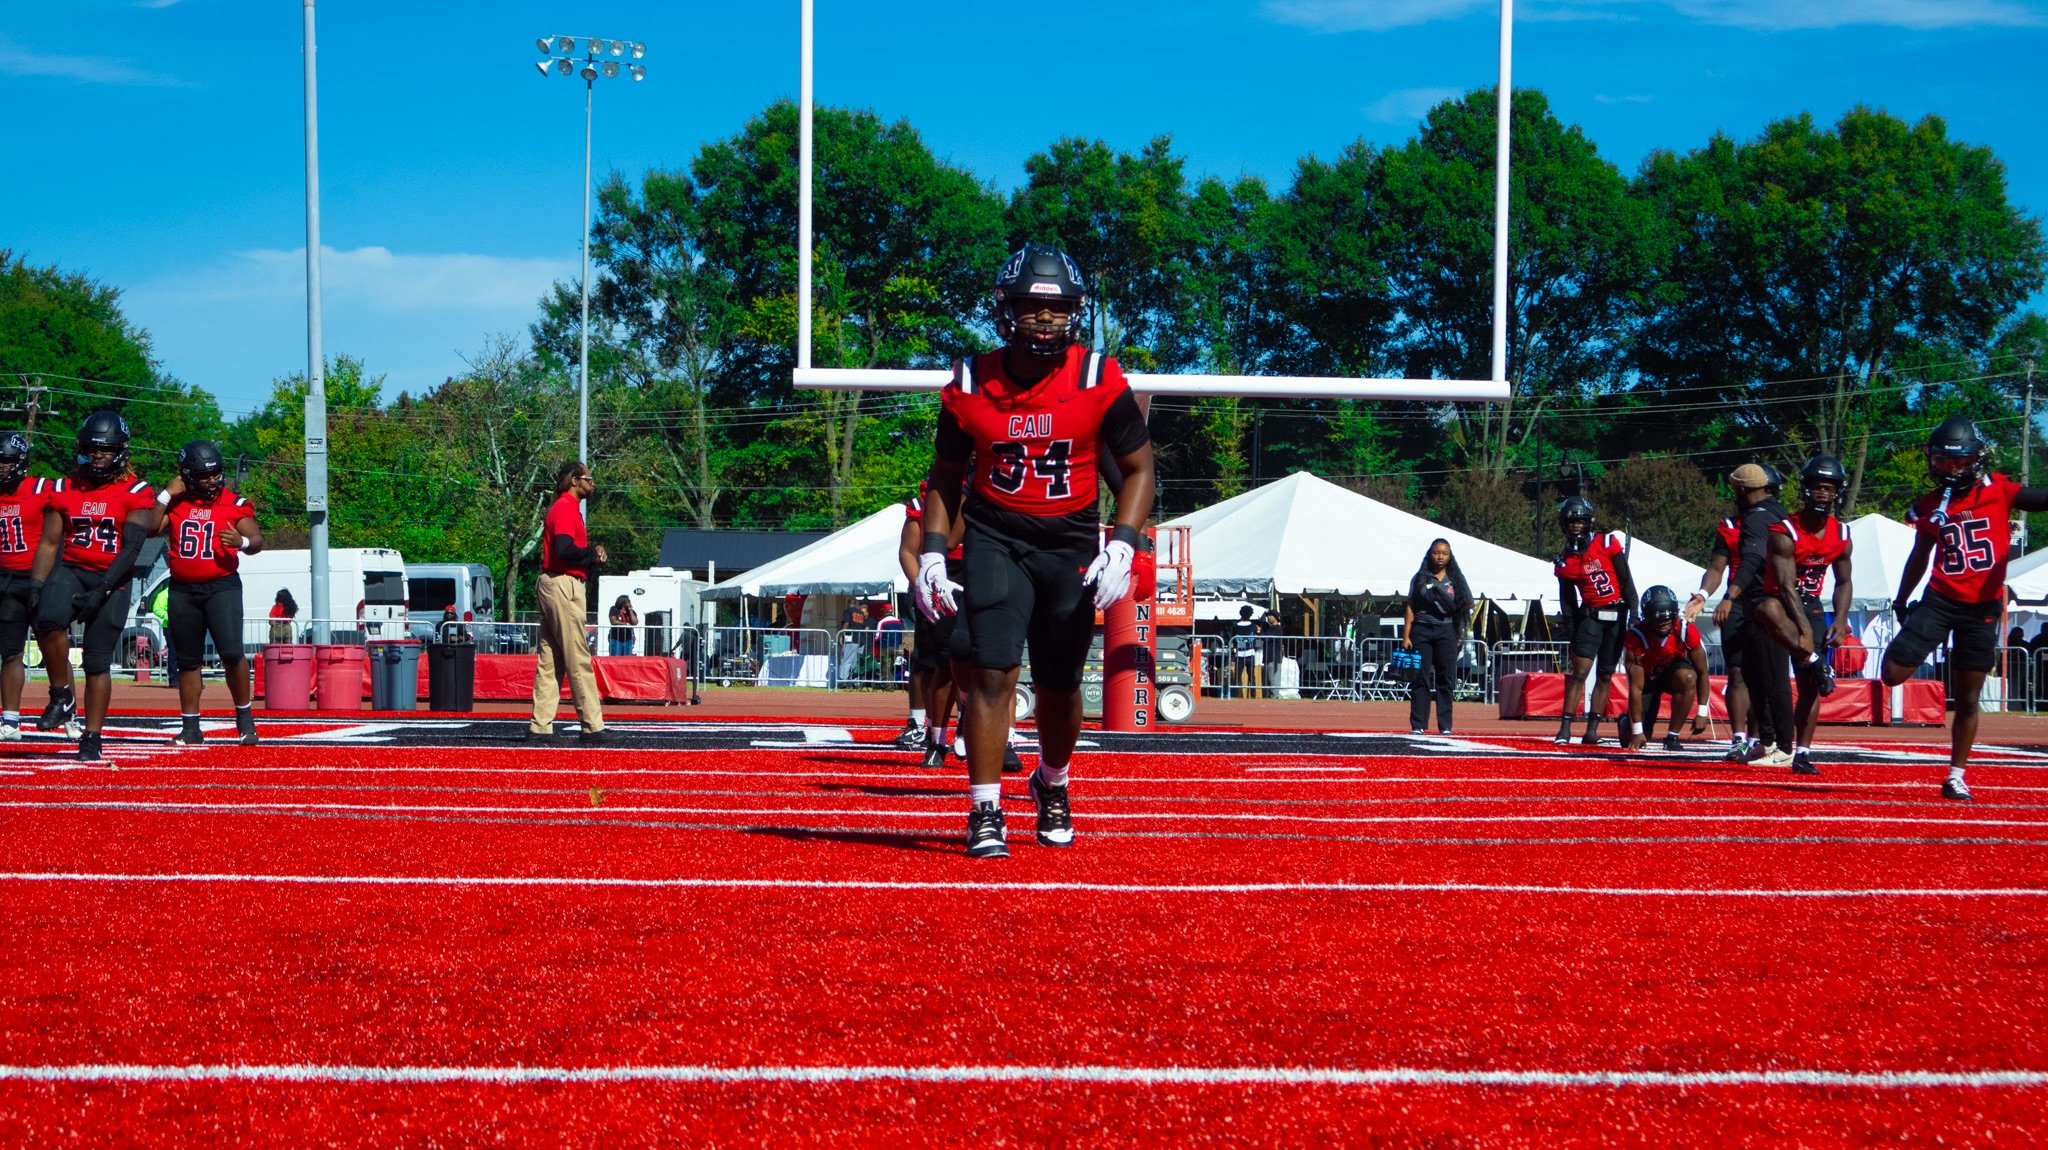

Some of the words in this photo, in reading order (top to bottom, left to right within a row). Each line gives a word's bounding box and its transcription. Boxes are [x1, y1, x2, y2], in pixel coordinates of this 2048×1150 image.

[1008, 413, 1052, 438] CAU
[989, 439, 1073, 499] 34
[0, 504, 21, 517] CAU
[82, 501, 107, 515] CAU
[189, 508, 212, 520] CAU
[0, 516, 28, 553] 11
[70, 516, 119, 554] 54
[179, 519, 216, 560] 61
[1938, 517, 1996, 575] 85
[1583, 559, 1602, 575] CAU
[1590, 569, 1615, 597] 2
[1167, 606, 1187, 616] 4626
[1134, 603, 1151, 726] NTHERS
